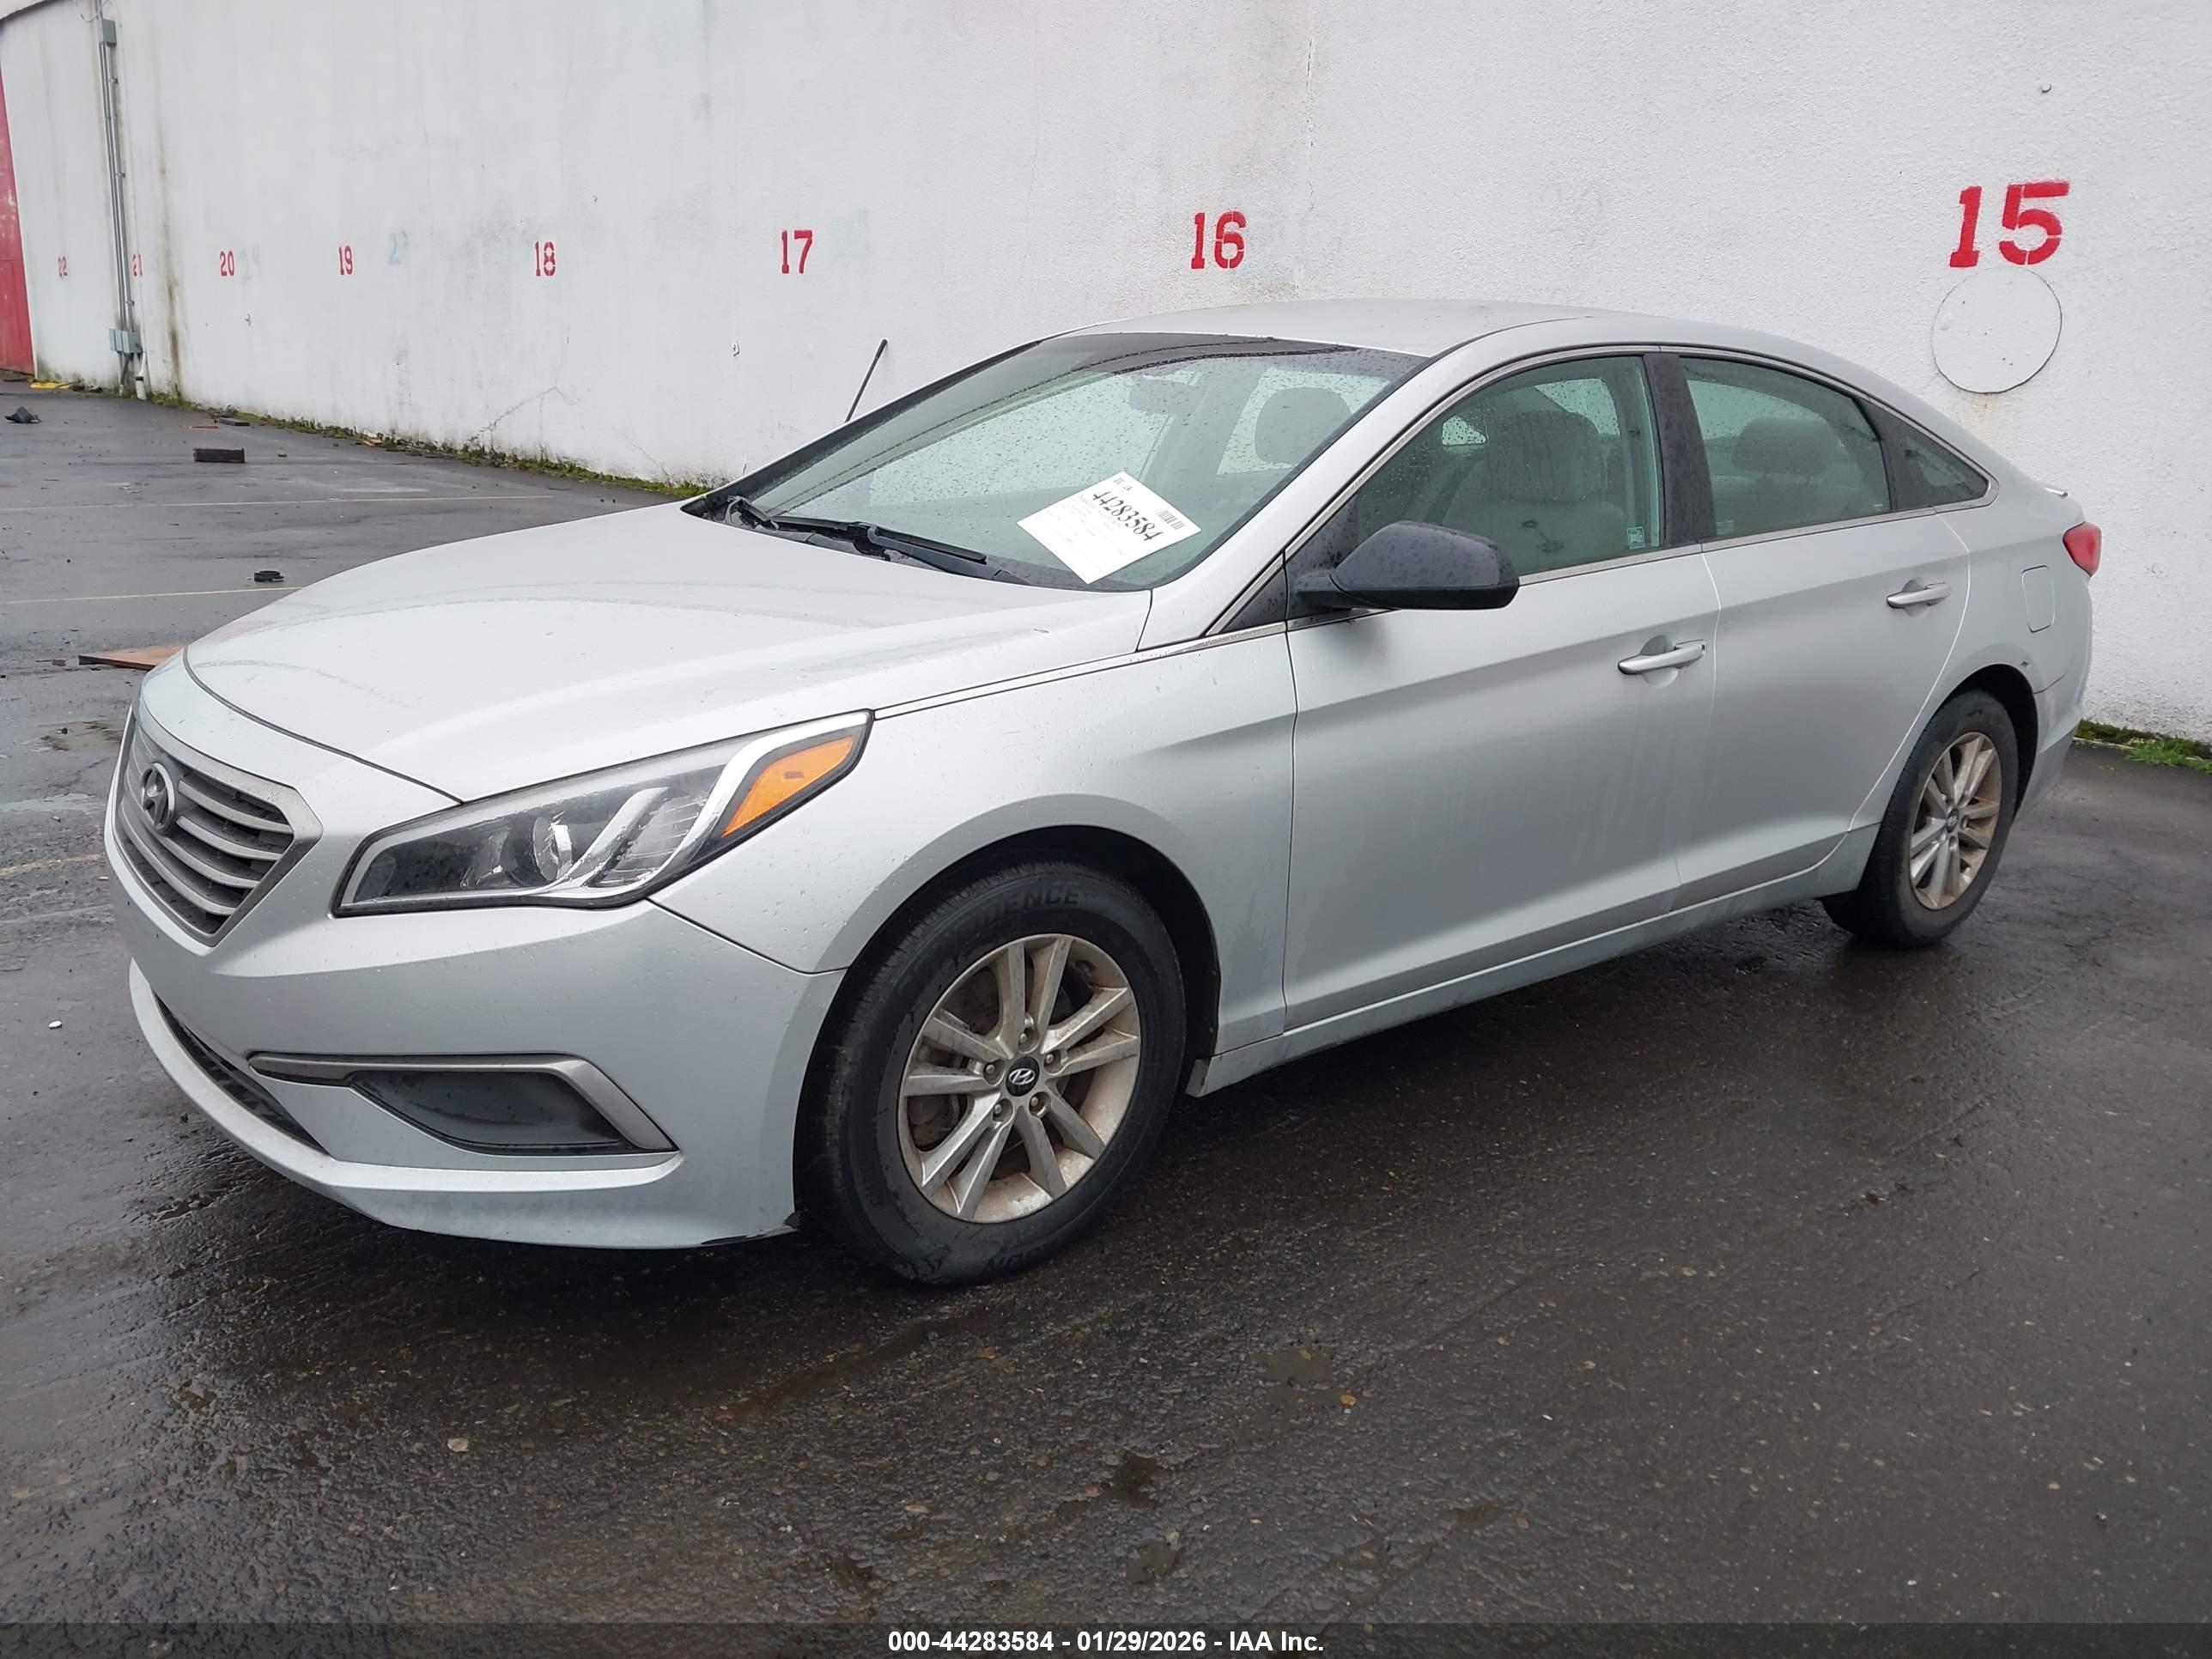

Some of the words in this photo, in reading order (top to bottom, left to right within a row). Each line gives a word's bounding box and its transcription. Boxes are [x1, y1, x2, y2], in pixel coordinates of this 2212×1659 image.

[1190, 210, 1247, 270] 16
[1948, 180, 2070, 270] 15
[57, 256, 69, 276] 22
[131, 253, 143, 276] 21
[219, 250, 234, 276] 20
[338, 246, 354, 275] 19
[535, 241, 556, 276] 18
[781, 229, 814, 275] 17
[1091, 490, 1164, 542] 44283584
